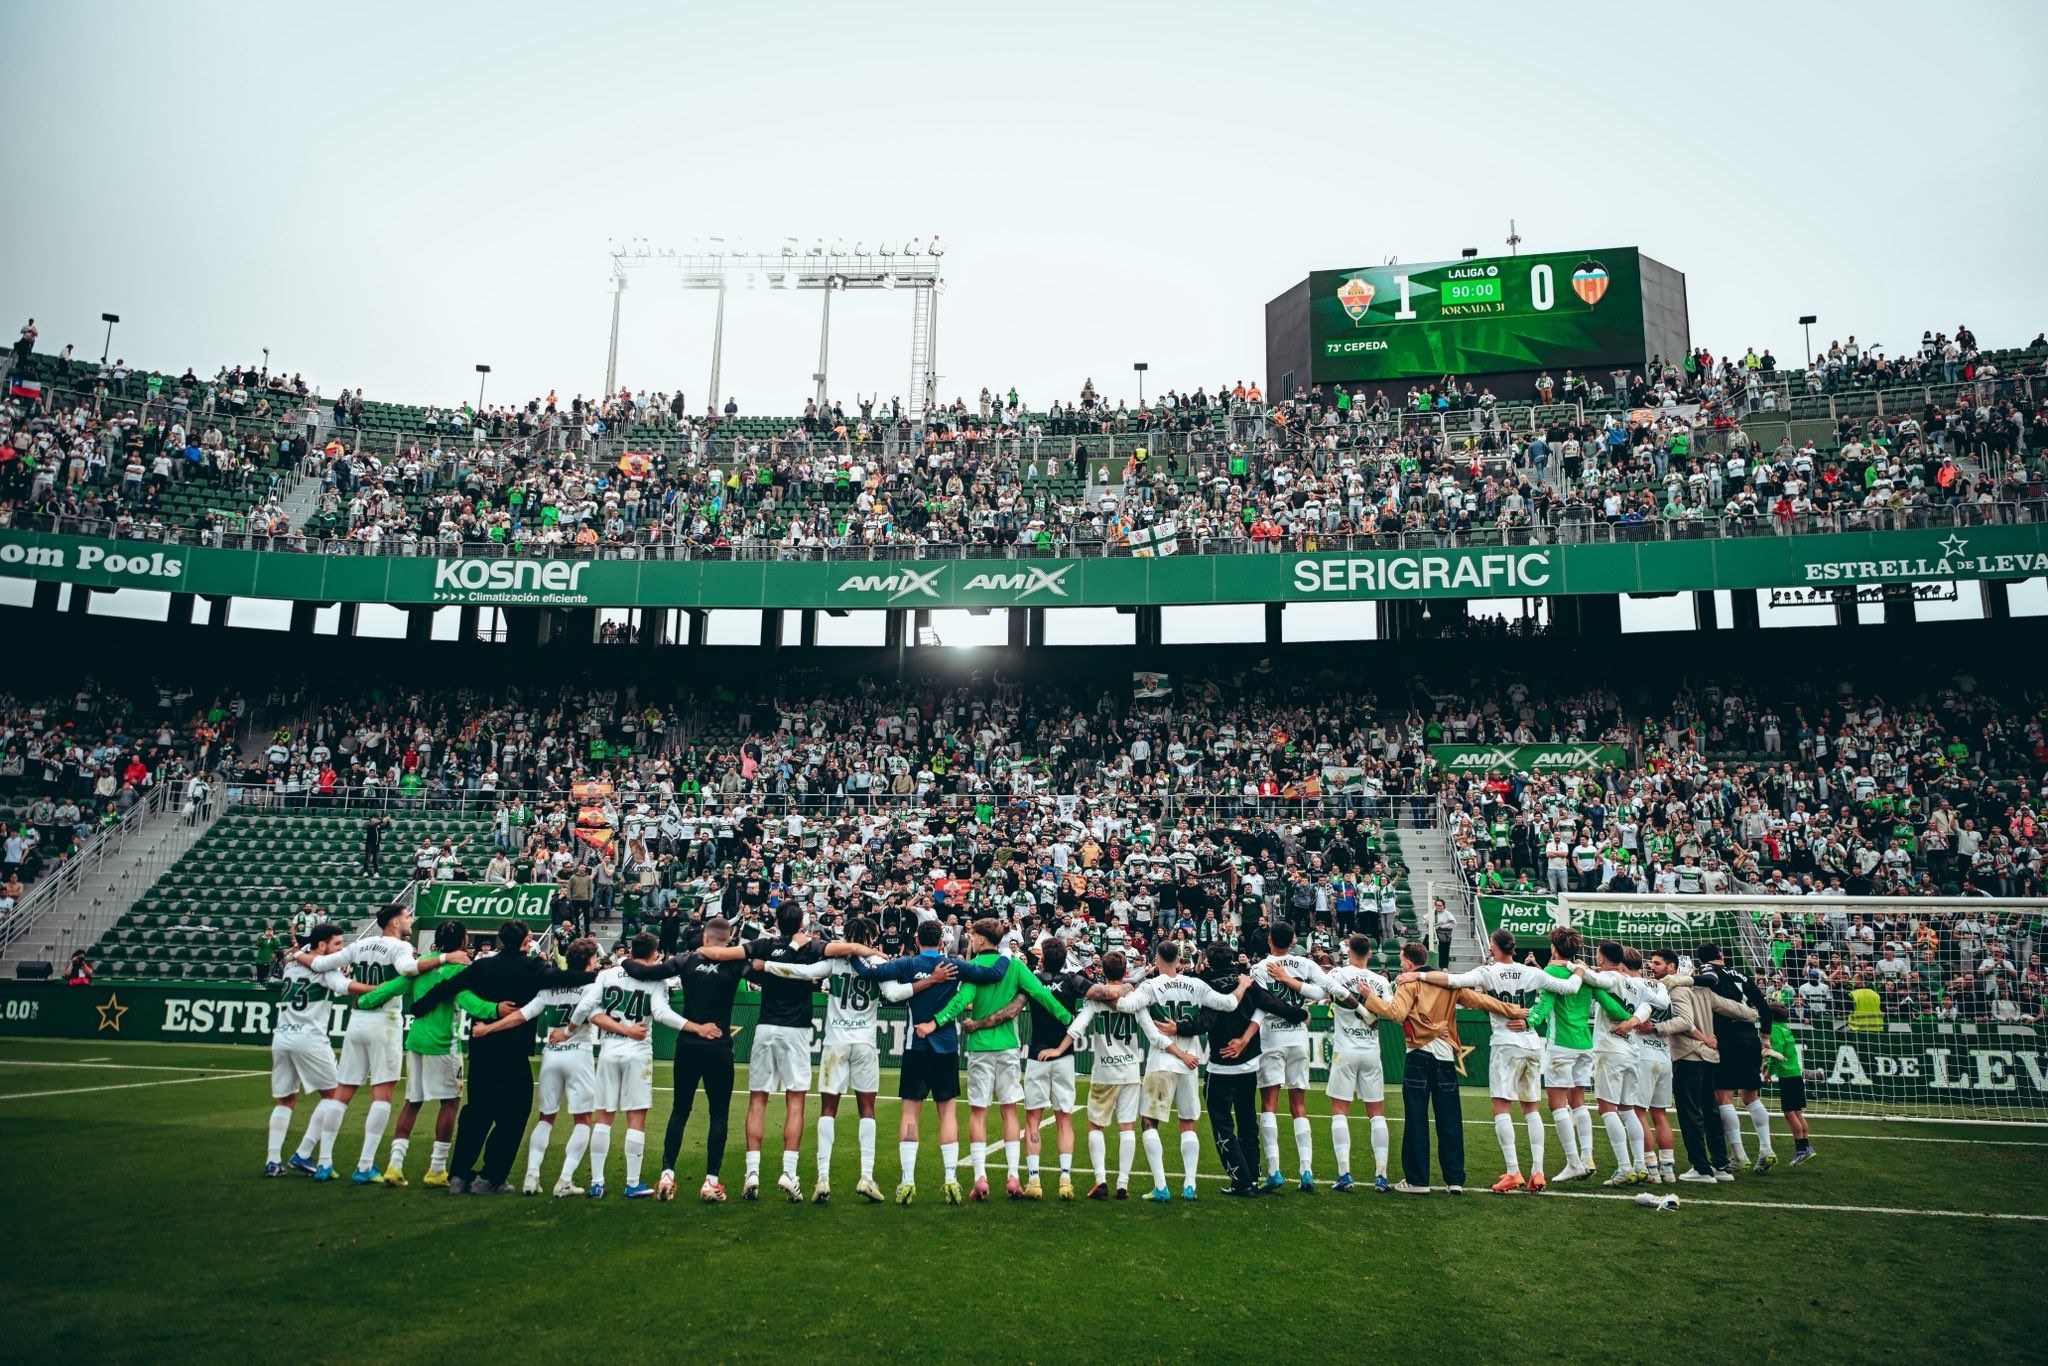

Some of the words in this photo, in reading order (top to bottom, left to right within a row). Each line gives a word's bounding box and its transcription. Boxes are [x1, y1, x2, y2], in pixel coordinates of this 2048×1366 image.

[1448, 267, 1485, 279] LALIGA
[1393, 275, 1417, 320] 1
[1452, 284, 1494, 298] 90:00
[1530, 263, 1555, 311] 0
[1441, 304, 1492, 316] JORNADA
[1496, 302, 1505, 312] 31
[1327, 343, 1342, 353] 73'
[1344, 341, 1388, 352] CEPEDA
[0, 544, 65, 568] om
[76, 545, 182, 577] Pools
[1294, 552, 1550, 592] SERIGRAFIC
[1804, 558, 1955, 581] ESTRELLA
[1957, 560, 1975, 571] DE
[1976, 553, 2048, 573] LEVA
[837, 564, 948, 602] AMIX
[963, 563, 1076, 601] AMIX
[468, 592, 541, 603] Climatización
[542, 593, 589, 604] eficiente
[1451, 746, 1522, 772] AMIX
[1533, 746, 1605, 770] AMIX
[441, 888, 556, 916] Ferrotal
[1501, 903, 1540, 917] Next
[1619, 904, 1658, 918] Next
[1570, 908, 1595, 927] 21
[1616, 919, 1681, 937] Energía
[1691, 909, 1717, 927] 21
[281, 976, 313, 1012] 23
[605, 985, 646, 1024] 24
[840, 971, 871, 1012] 18
[1100, 1010, 1132, 1047] 14
[1874, 1056, 1920, 1078] DE
